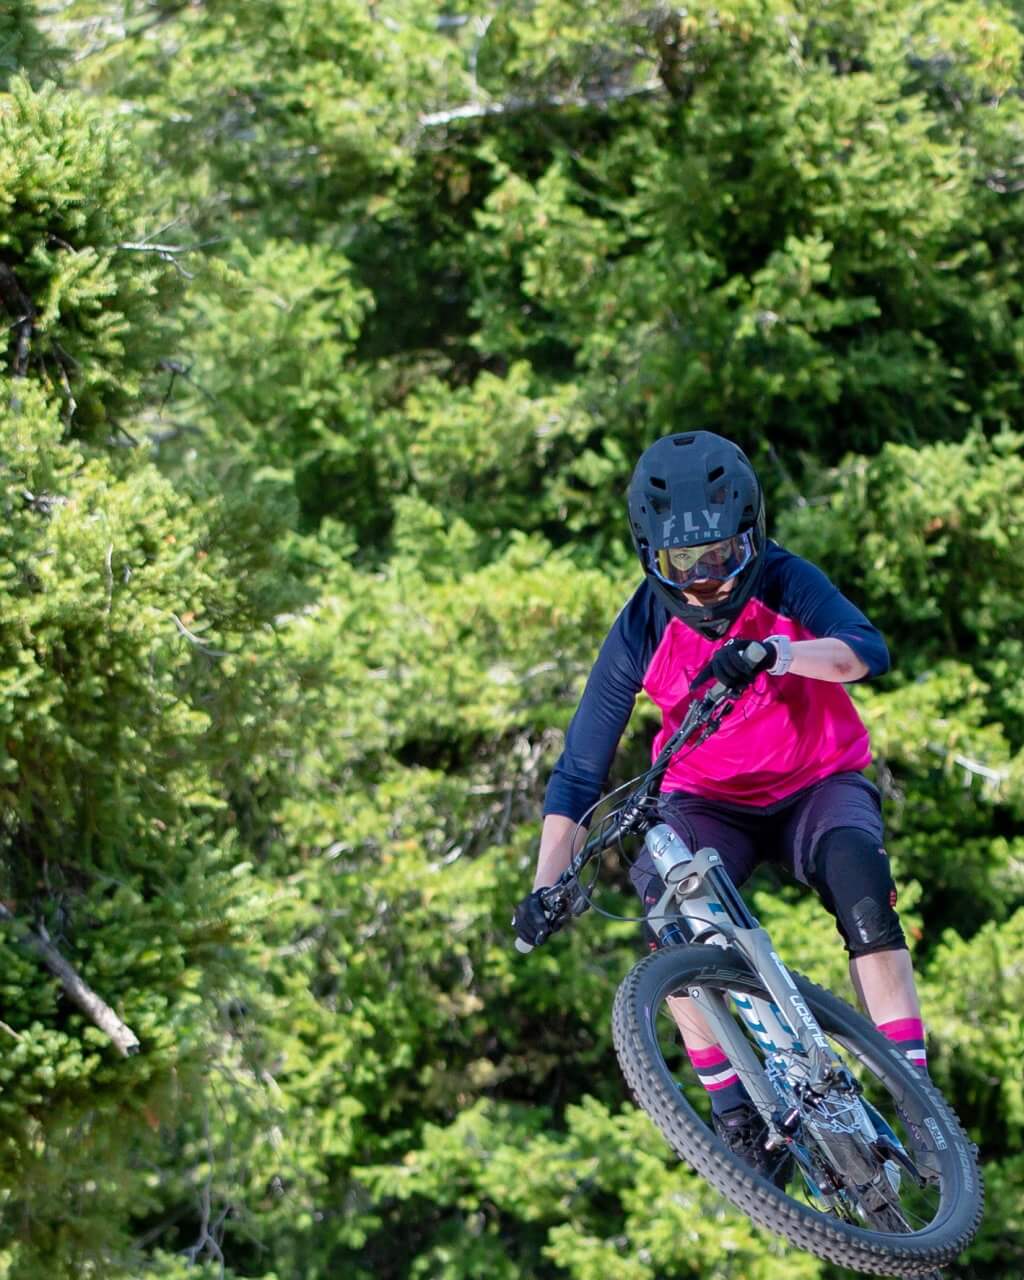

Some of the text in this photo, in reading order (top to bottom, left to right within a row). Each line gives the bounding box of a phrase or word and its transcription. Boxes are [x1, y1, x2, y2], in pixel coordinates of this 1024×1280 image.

[663, 509, 721, 538] FLY
[663, 530, 721, 548] RACING
[790, 995, 829, 1048] AURON
[921, 1085, 960, 1136] MARY
